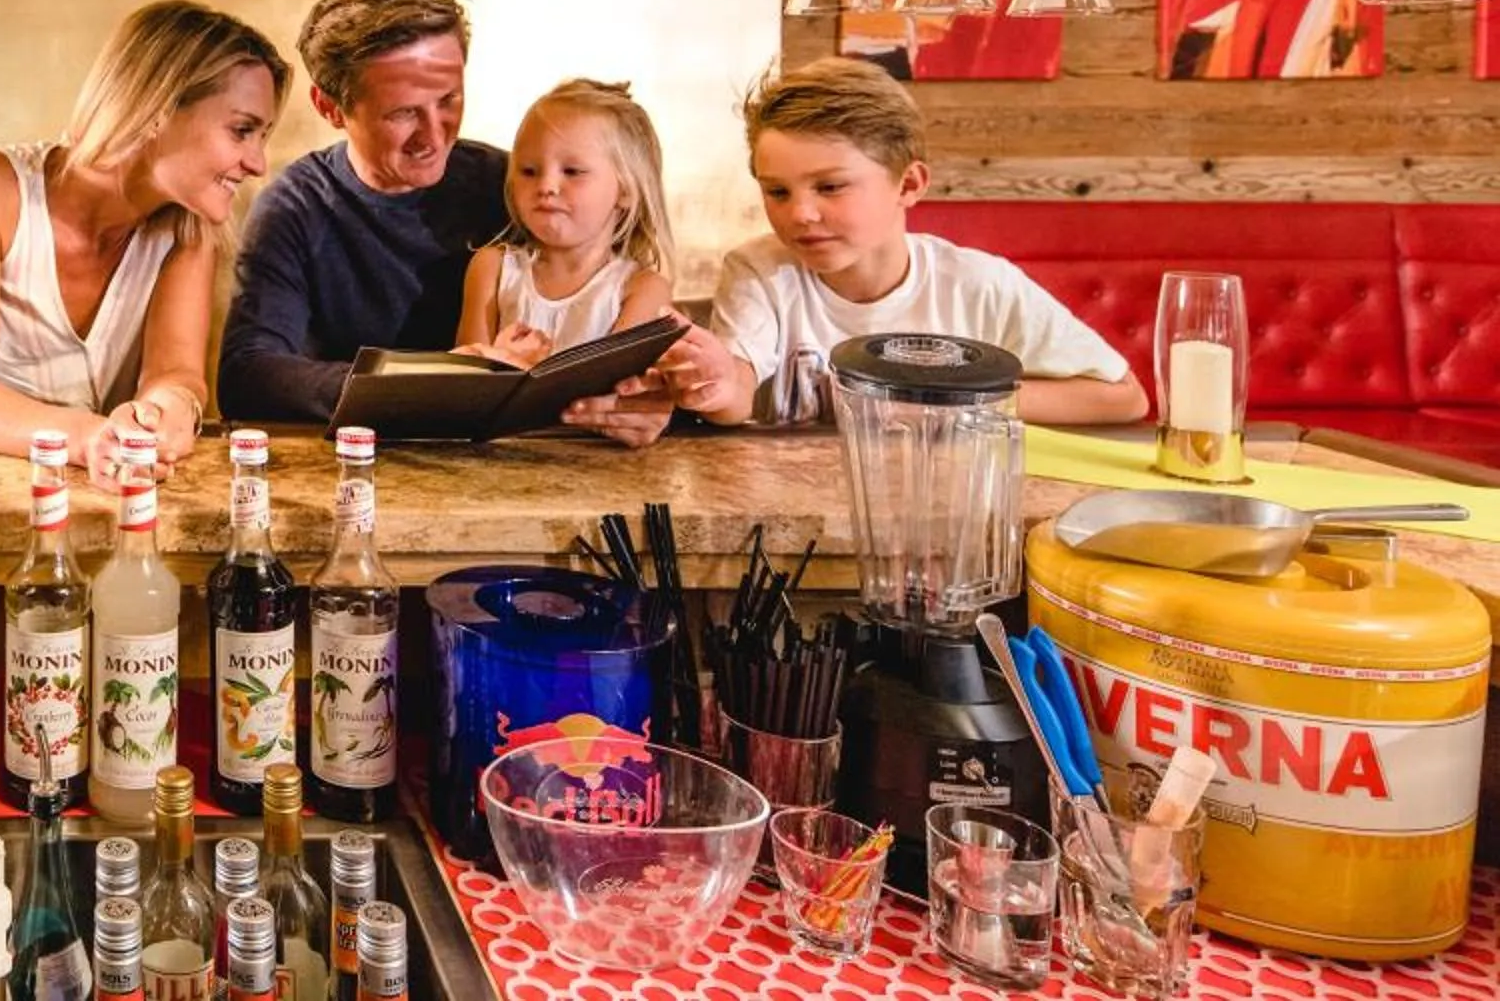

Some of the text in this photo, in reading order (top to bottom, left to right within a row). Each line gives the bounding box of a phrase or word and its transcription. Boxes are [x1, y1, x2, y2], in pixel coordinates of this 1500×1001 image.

[10, 649, 83, 670] MONIN
[104, 651, 176, 675] MONIN
[318, 651, 392, 674] MONIN
[1064, 656, 1390, 800] VERNA
